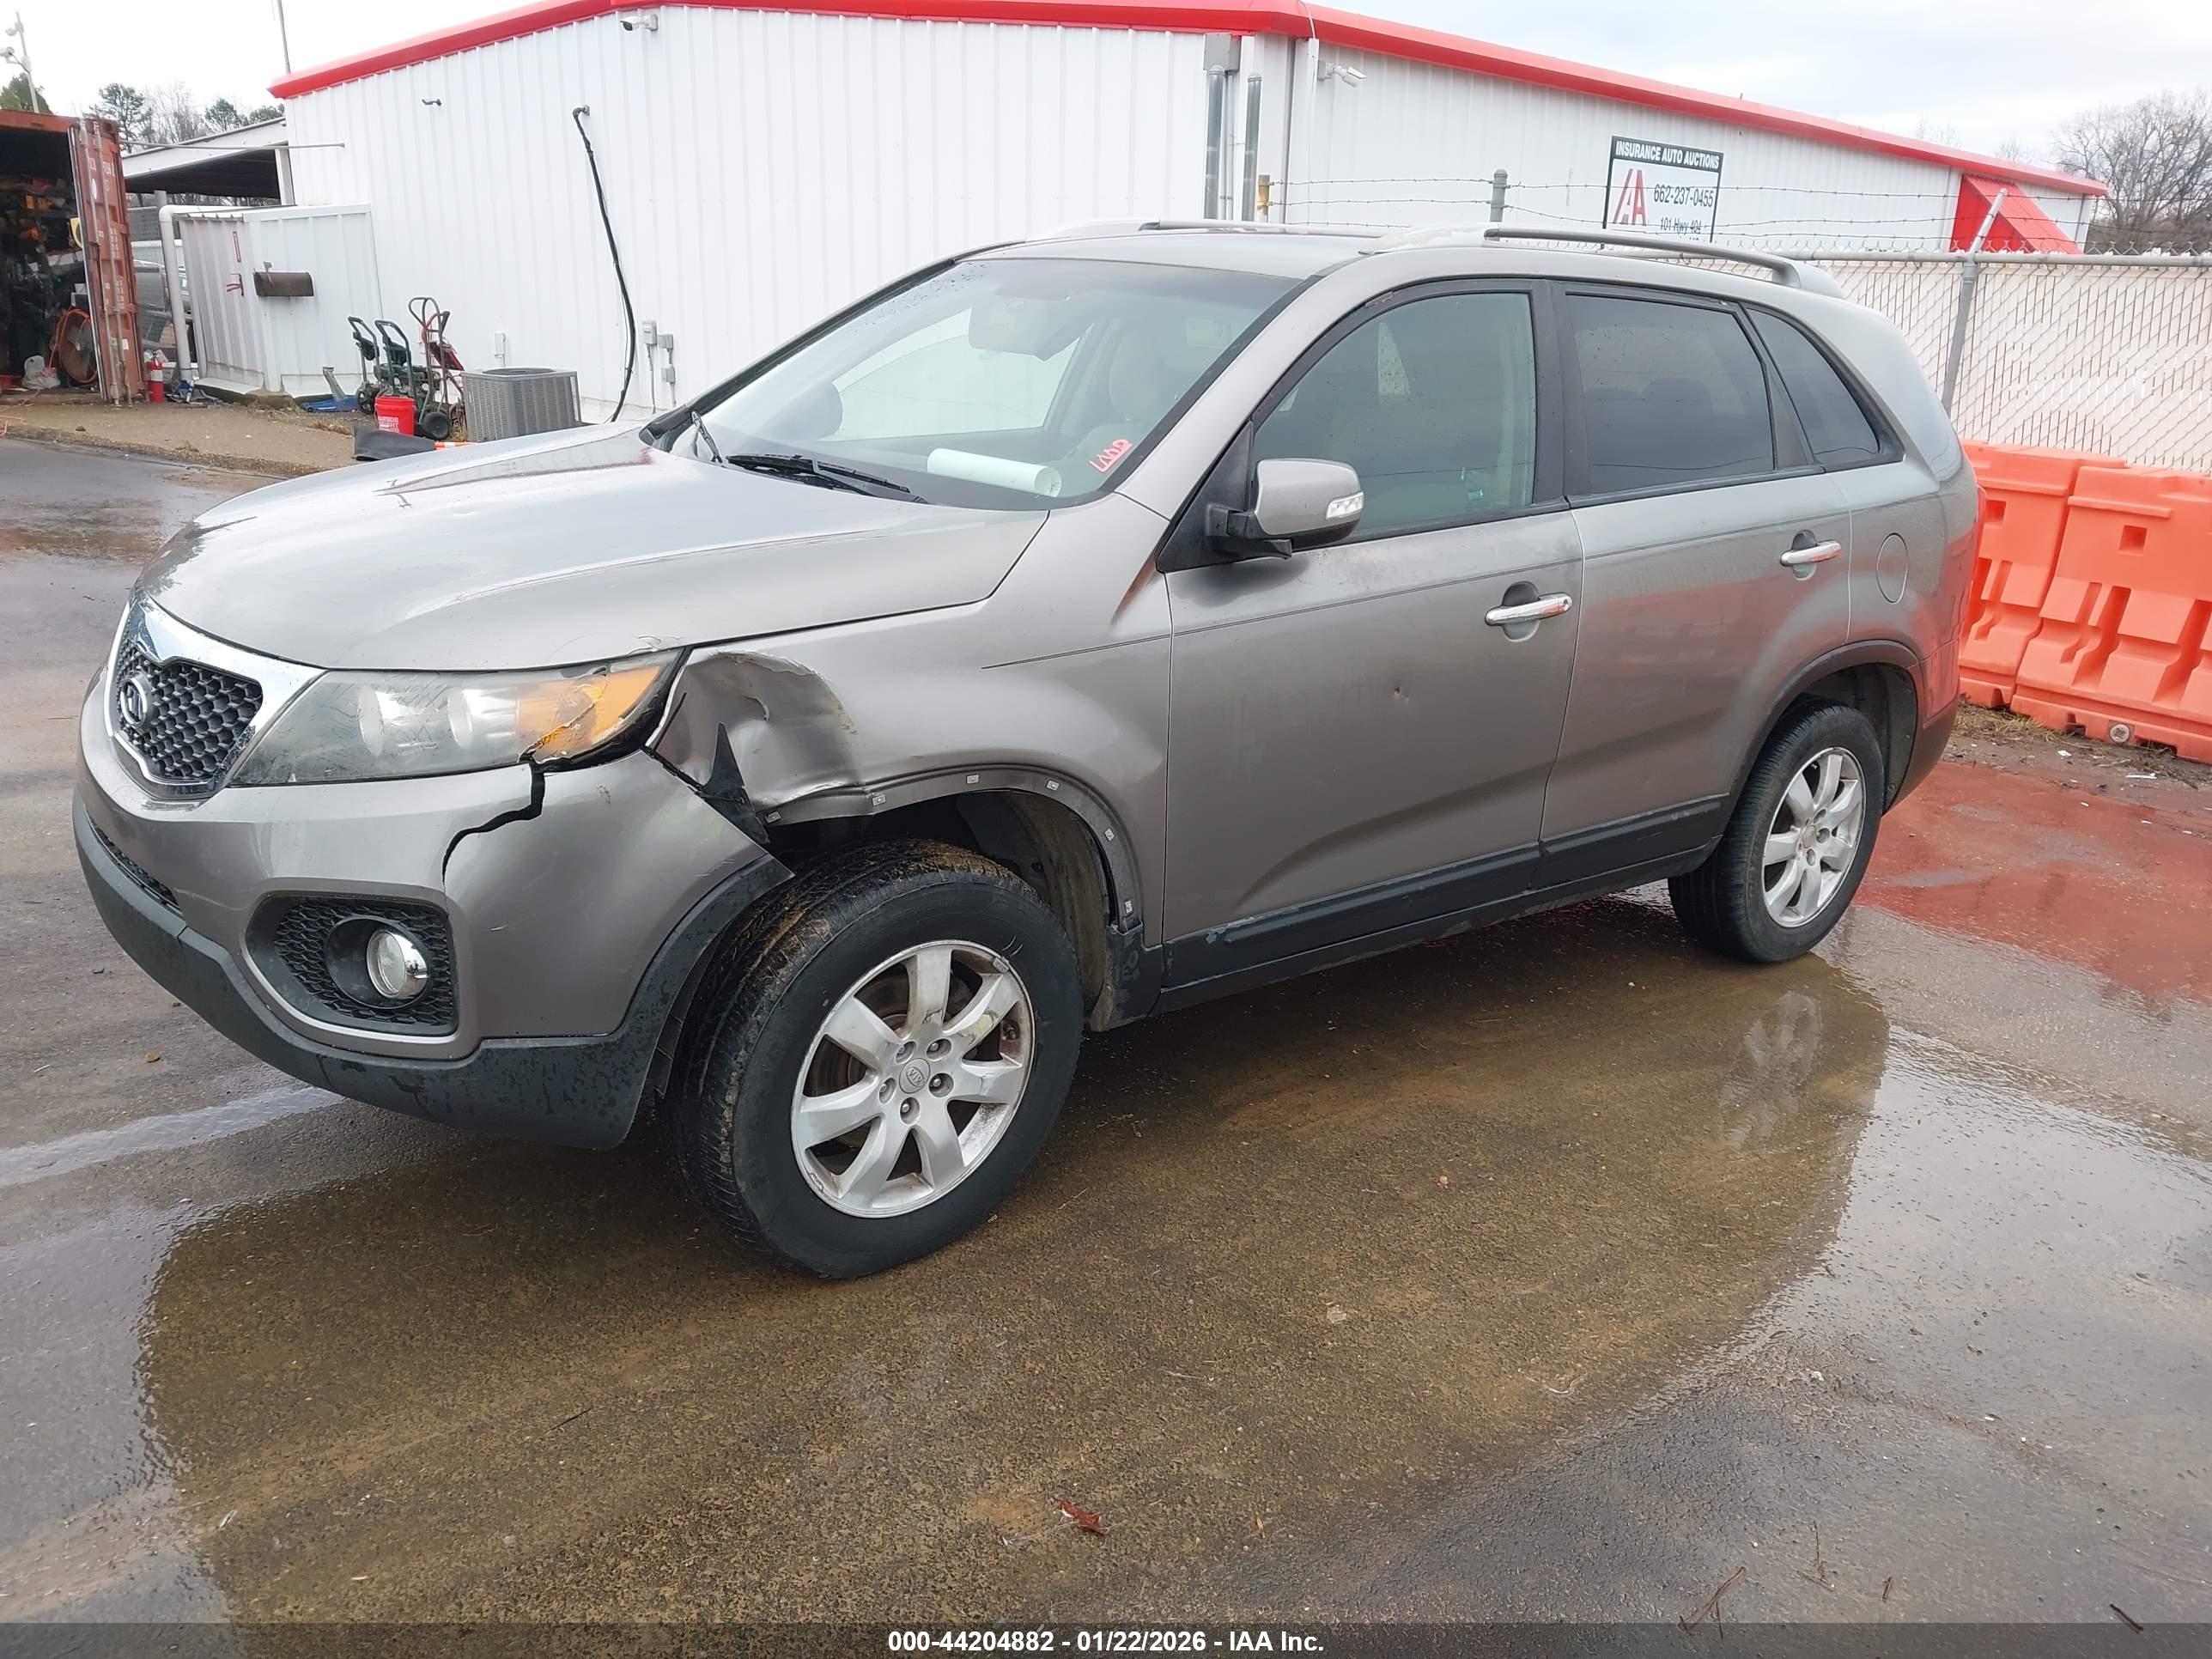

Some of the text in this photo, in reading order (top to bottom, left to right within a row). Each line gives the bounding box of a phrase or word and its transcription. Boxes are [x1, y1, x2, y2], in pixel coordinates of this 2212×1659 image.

[1615, 140, 1720, 169] INSURANCE AUTO AUCTIONS
[1654, 183, 1714, 208] 662-237-0455
[1673, 217, 1689, 235] Hwy
